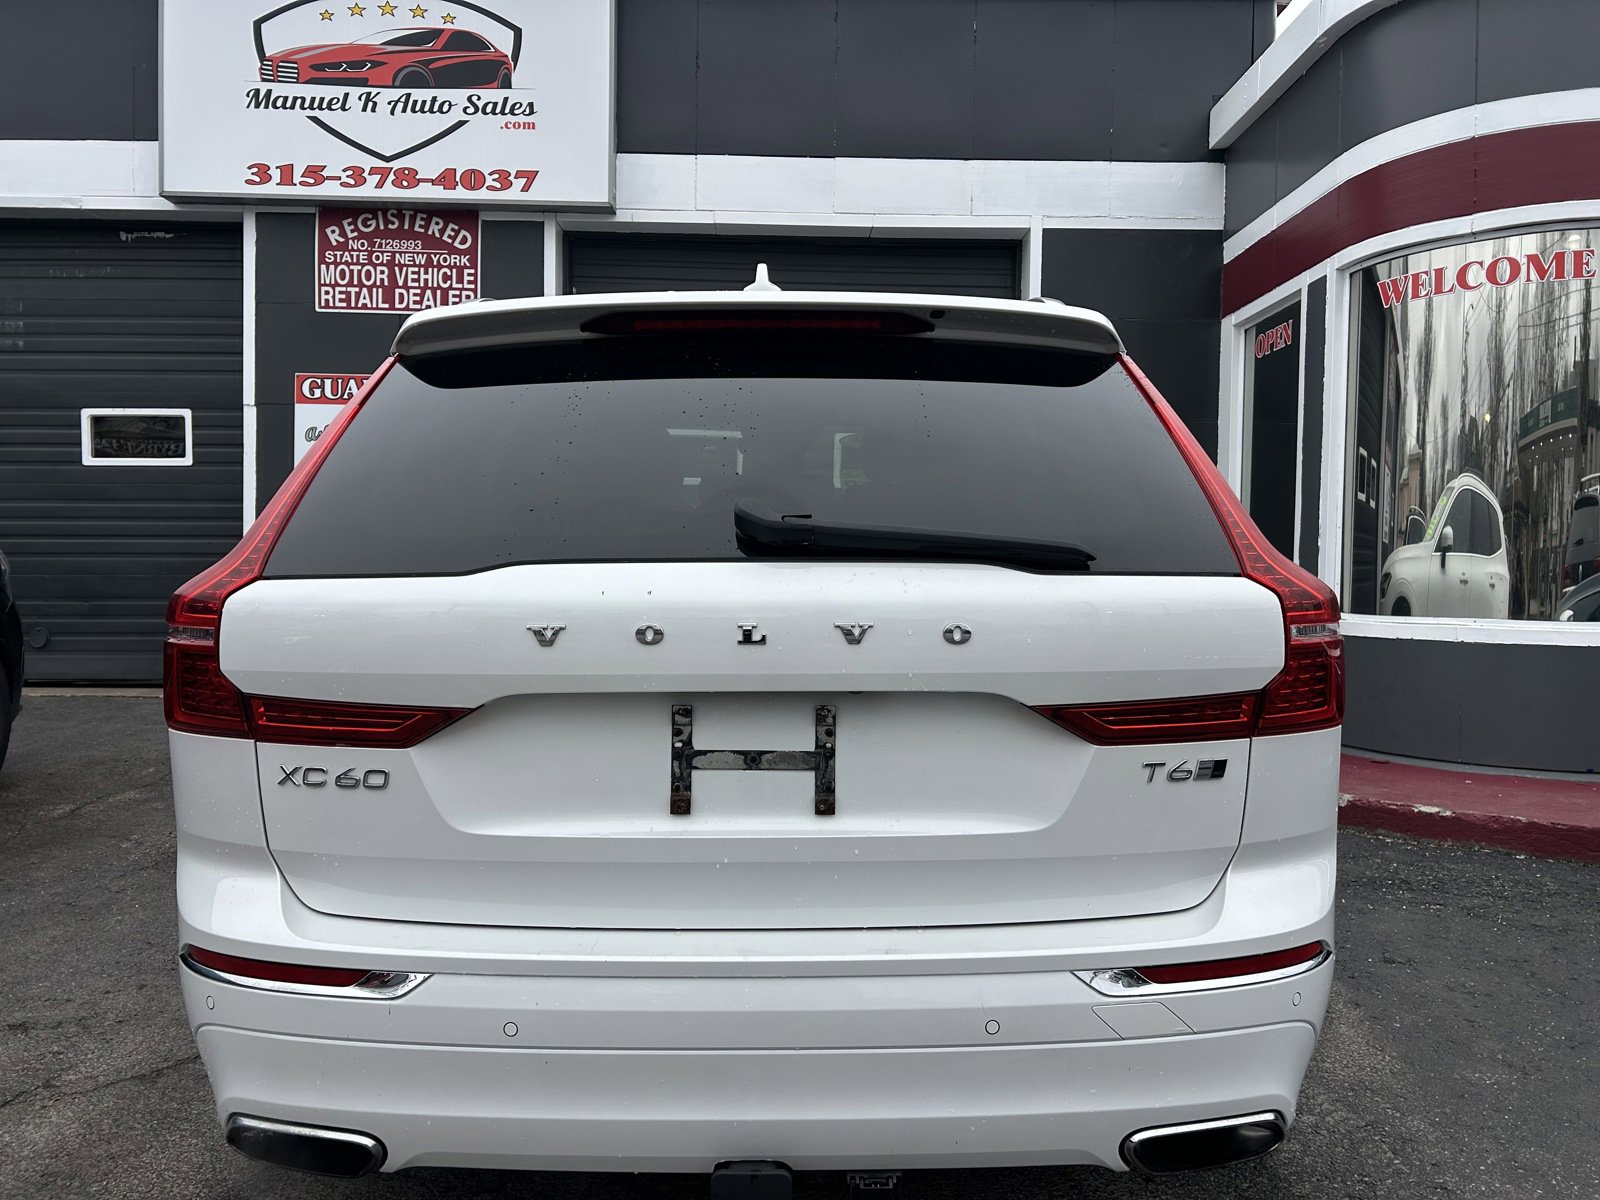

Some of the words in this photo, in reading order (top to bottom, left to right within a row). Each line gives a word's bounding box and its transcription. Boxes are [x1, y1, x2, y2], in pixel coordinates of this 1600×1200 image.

[245, 87, 352, 112] Manuel
[357, 91, 382, 113] K
[387, 92, 458, 116] Auto
[462, 94, 538, 117] Sales
[500, 120, 536, 130] .com
[244, 163, 540, 193] 315-378-4037
[325, 209, 472, 250] REGISTERED
[348, 239, 371, 251] NO.
[373, 238, 422, 250] 7126993
[325, 251, 368, 263] STATE
[372, 252, 392, 264] OF
[395, 253, 427, 265] NEW
[431, 254, 471, 267] YORK
[320, 264, 389, 286] MOTOR
[394, 266, 475, 289] VEHICLE
[1377, 248, 1597, 308] WELCOME
[320, 286, 389, 308] RETAIL
[1255, 319, 1293, 359] OPEN
[301, 377, 369, 400] GUA
[525, 622, 972, 647] VOLVO
[277, 763, 391, 790] XC60
